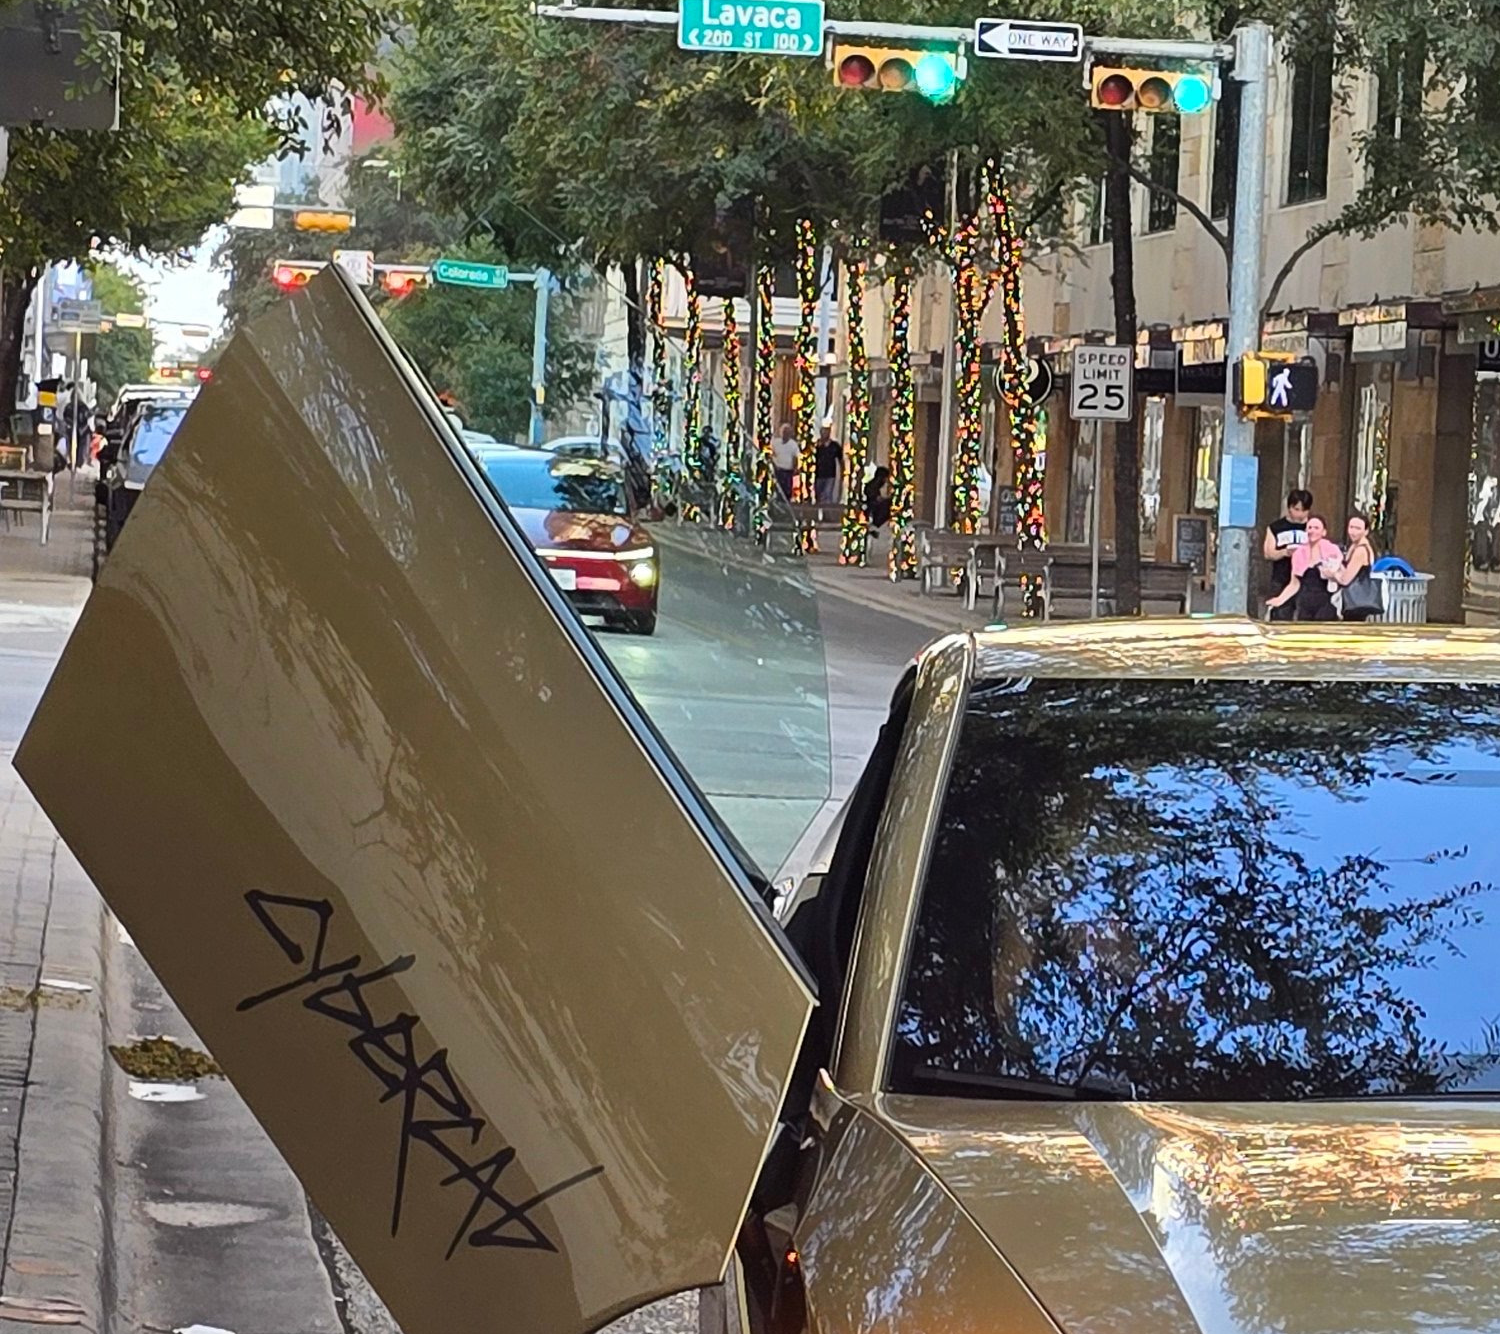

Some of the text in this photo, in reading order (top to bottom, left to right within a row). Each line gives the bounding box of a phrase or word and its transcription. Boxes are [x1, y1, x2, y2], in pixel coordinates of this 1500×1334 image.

[702, 29, 800, 51] 200 ST 100
[1008, 32, 1070, 48] ONE WAY
[1078, 353, 1127, 366] SPEED
[1083, 368, 1121, 381] LIMIT
[1077, 383, 1125, 411] 25
